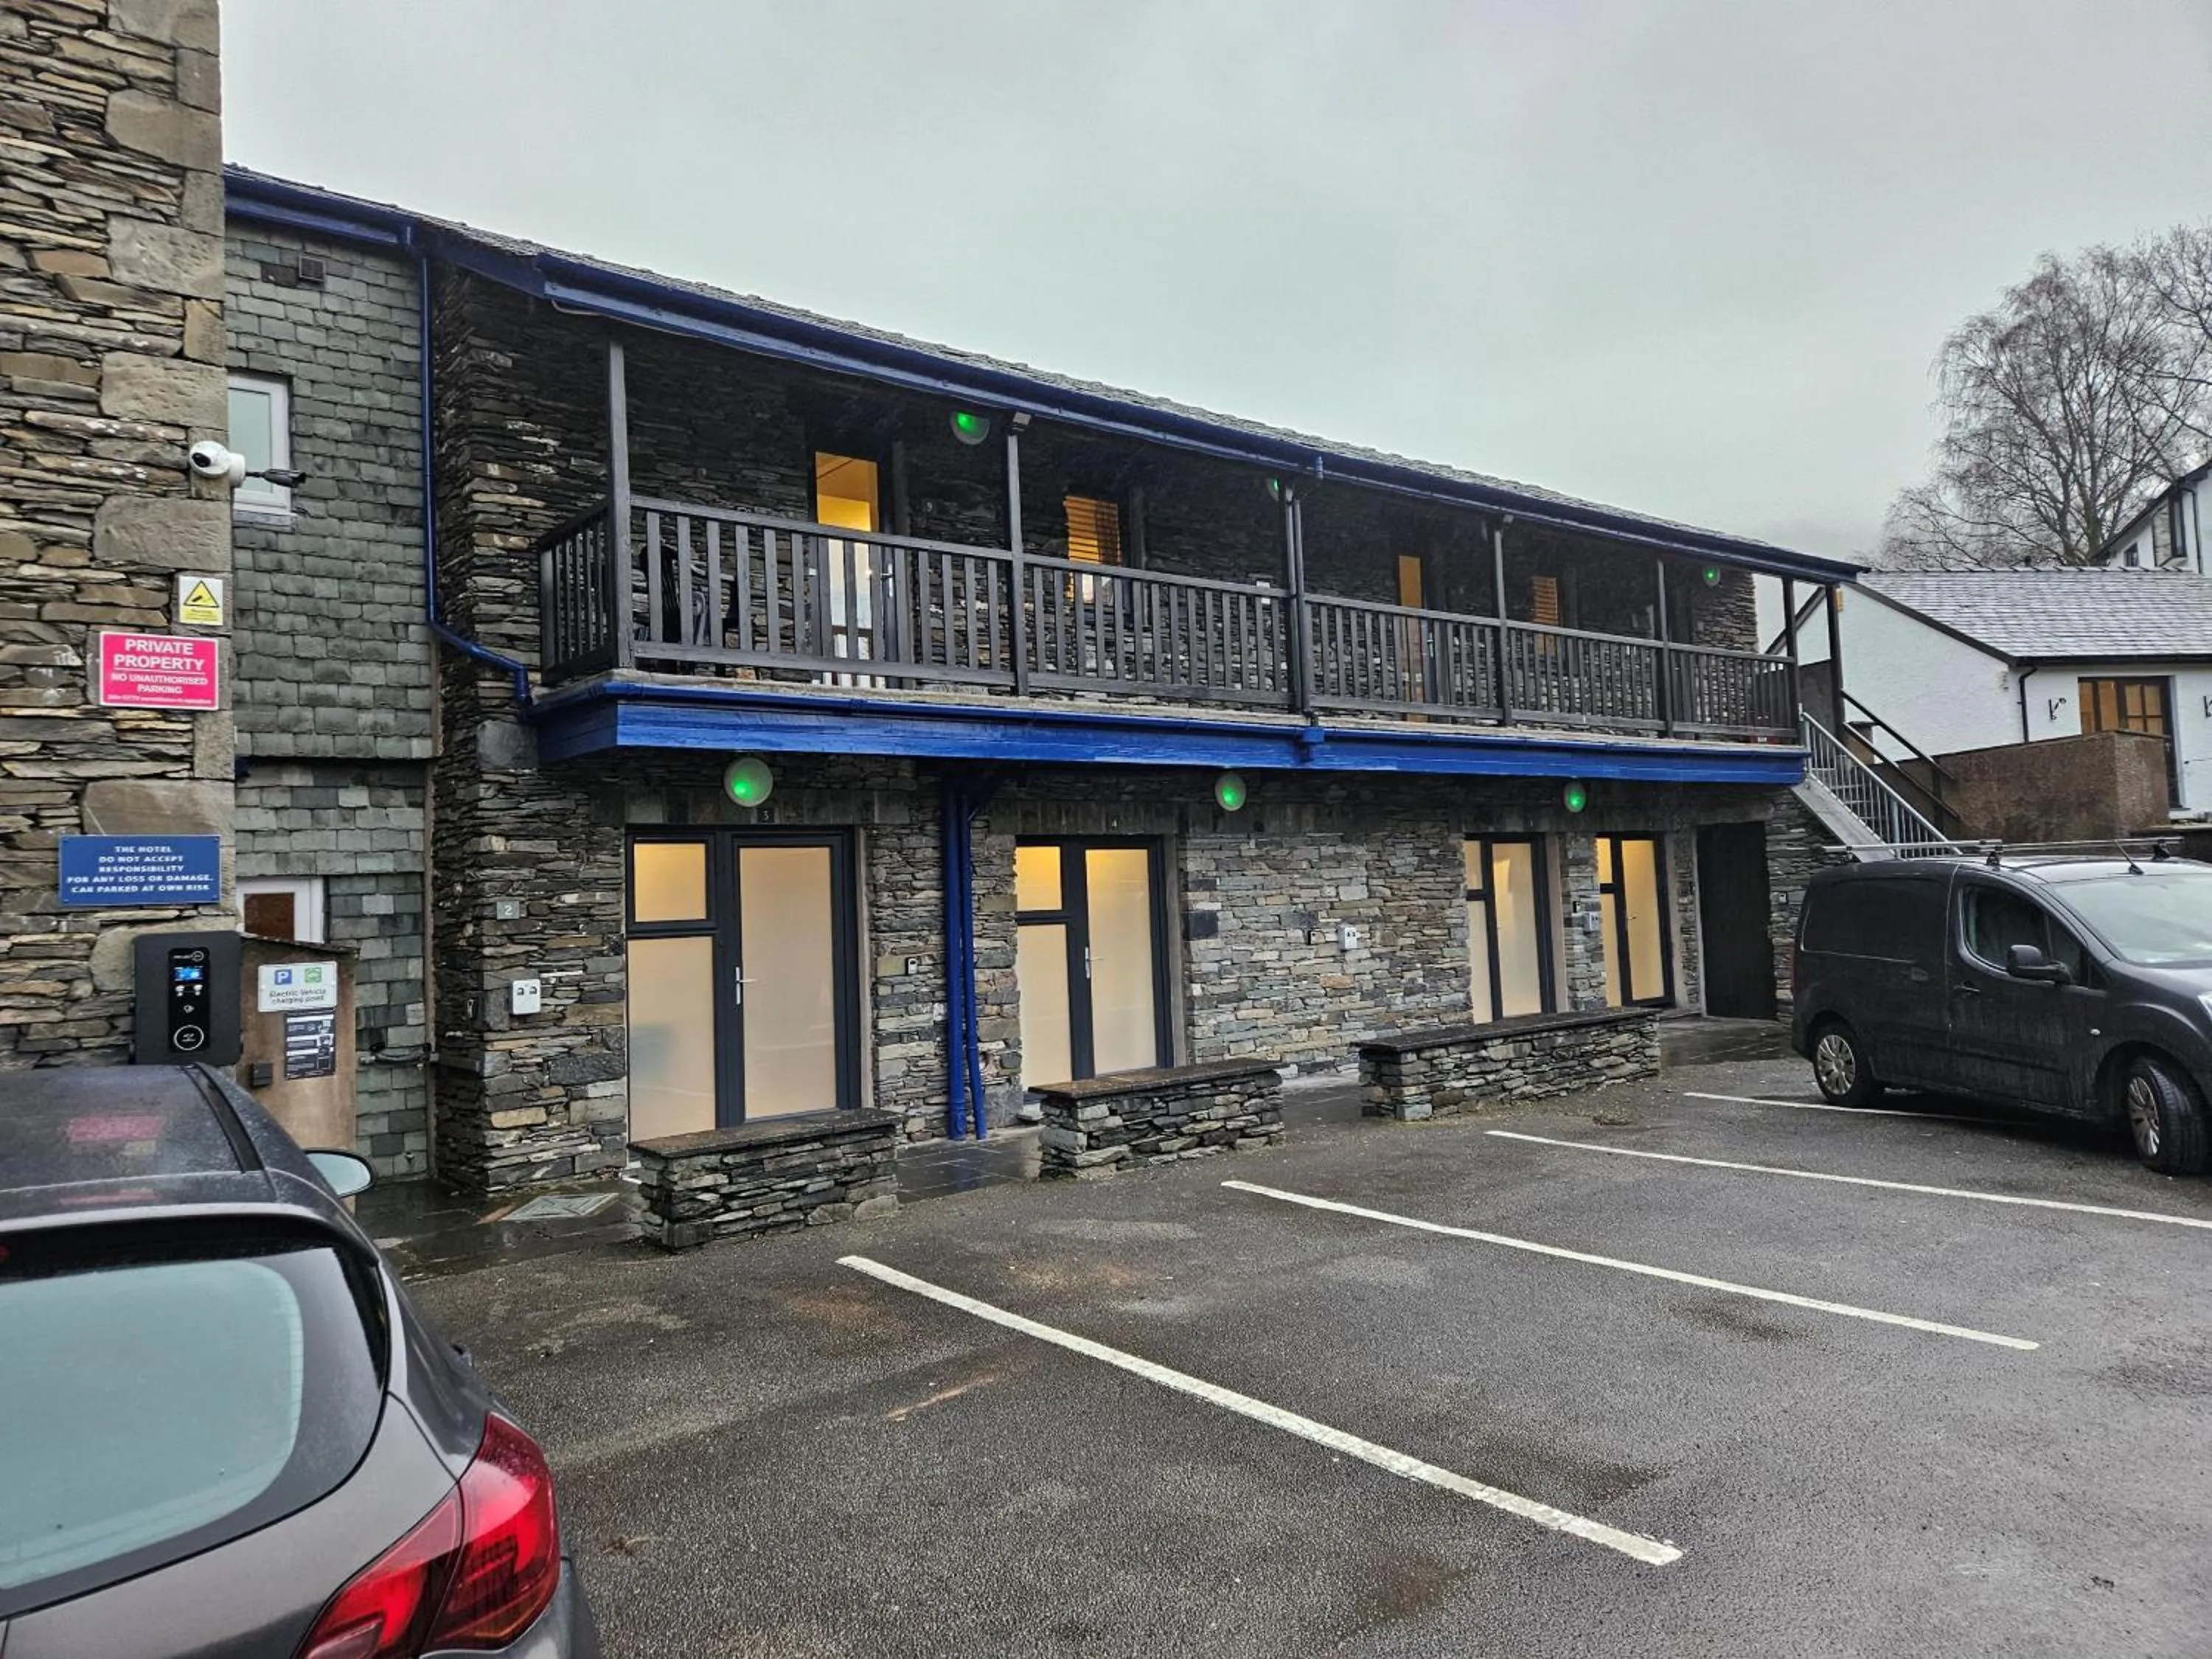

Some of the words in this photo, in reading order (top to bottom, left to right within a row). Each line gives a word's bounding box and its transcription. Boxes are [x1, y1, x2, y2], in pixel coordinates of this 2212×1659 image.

[125, 639, 194, 655] PRIVATE
[114, 654, 204, 671] PROPERTY
[111, 672, 127, 681] NO
[130, 674, 208, 685] UNAUTHORISED
[137, 684, 183, 694] PARKING
[504, 905, 512, 915] 2
[277, 971, 289, 984] P
